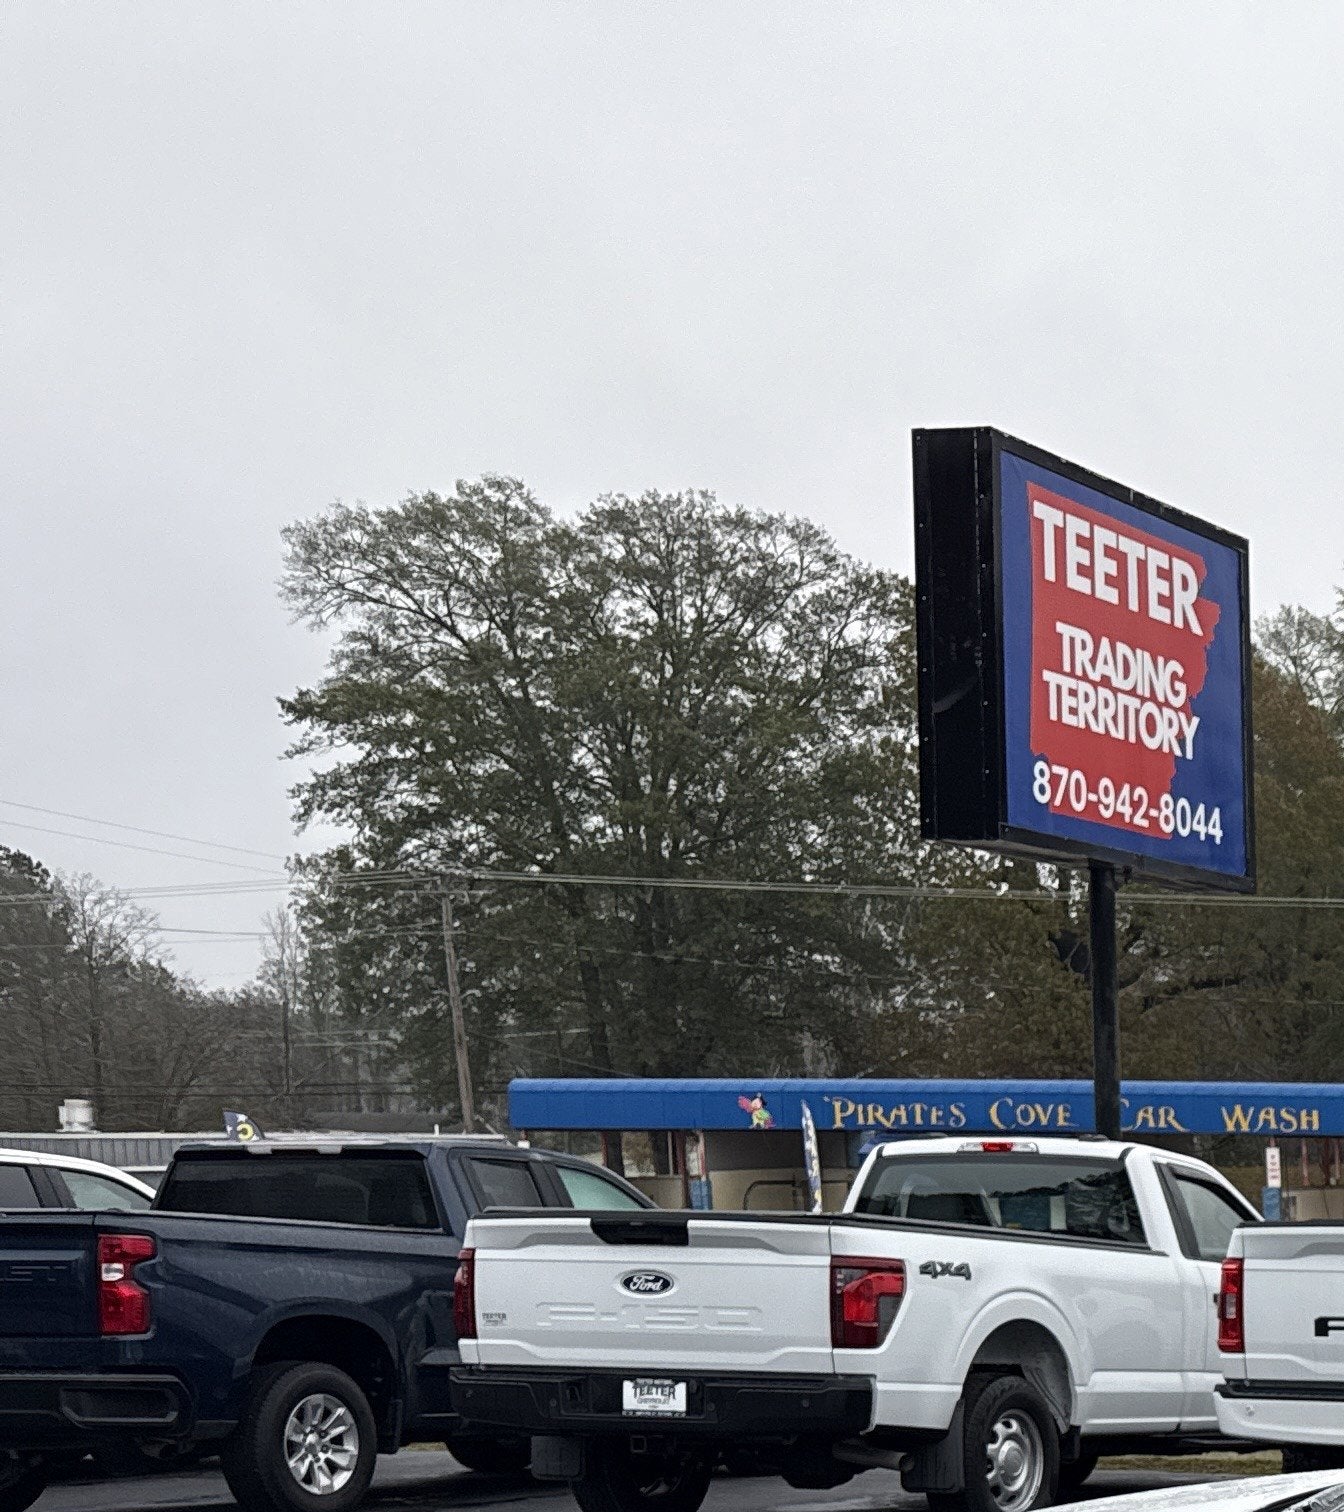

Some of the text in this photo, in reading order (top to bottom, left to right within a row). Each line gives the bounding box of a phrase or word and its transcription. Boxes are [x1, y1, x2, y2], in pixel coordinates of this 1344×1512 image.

[1032, 499, 1204, 636] TEETER
[1055, 620, 1187, 708] TRADING
[1042, 669, 1200, 760] TERRITORY
[1032, 760, 1223, 845] 870-942-8044
[989, 1097, 1079, 1130] COVE
[1221, 1103, 1320, 1133] WASH
[630, 1273, 663, 1293] Ford
[536, 1301, 762, 1331] F-150
[632, 1381, 676, 1400] TEETER
